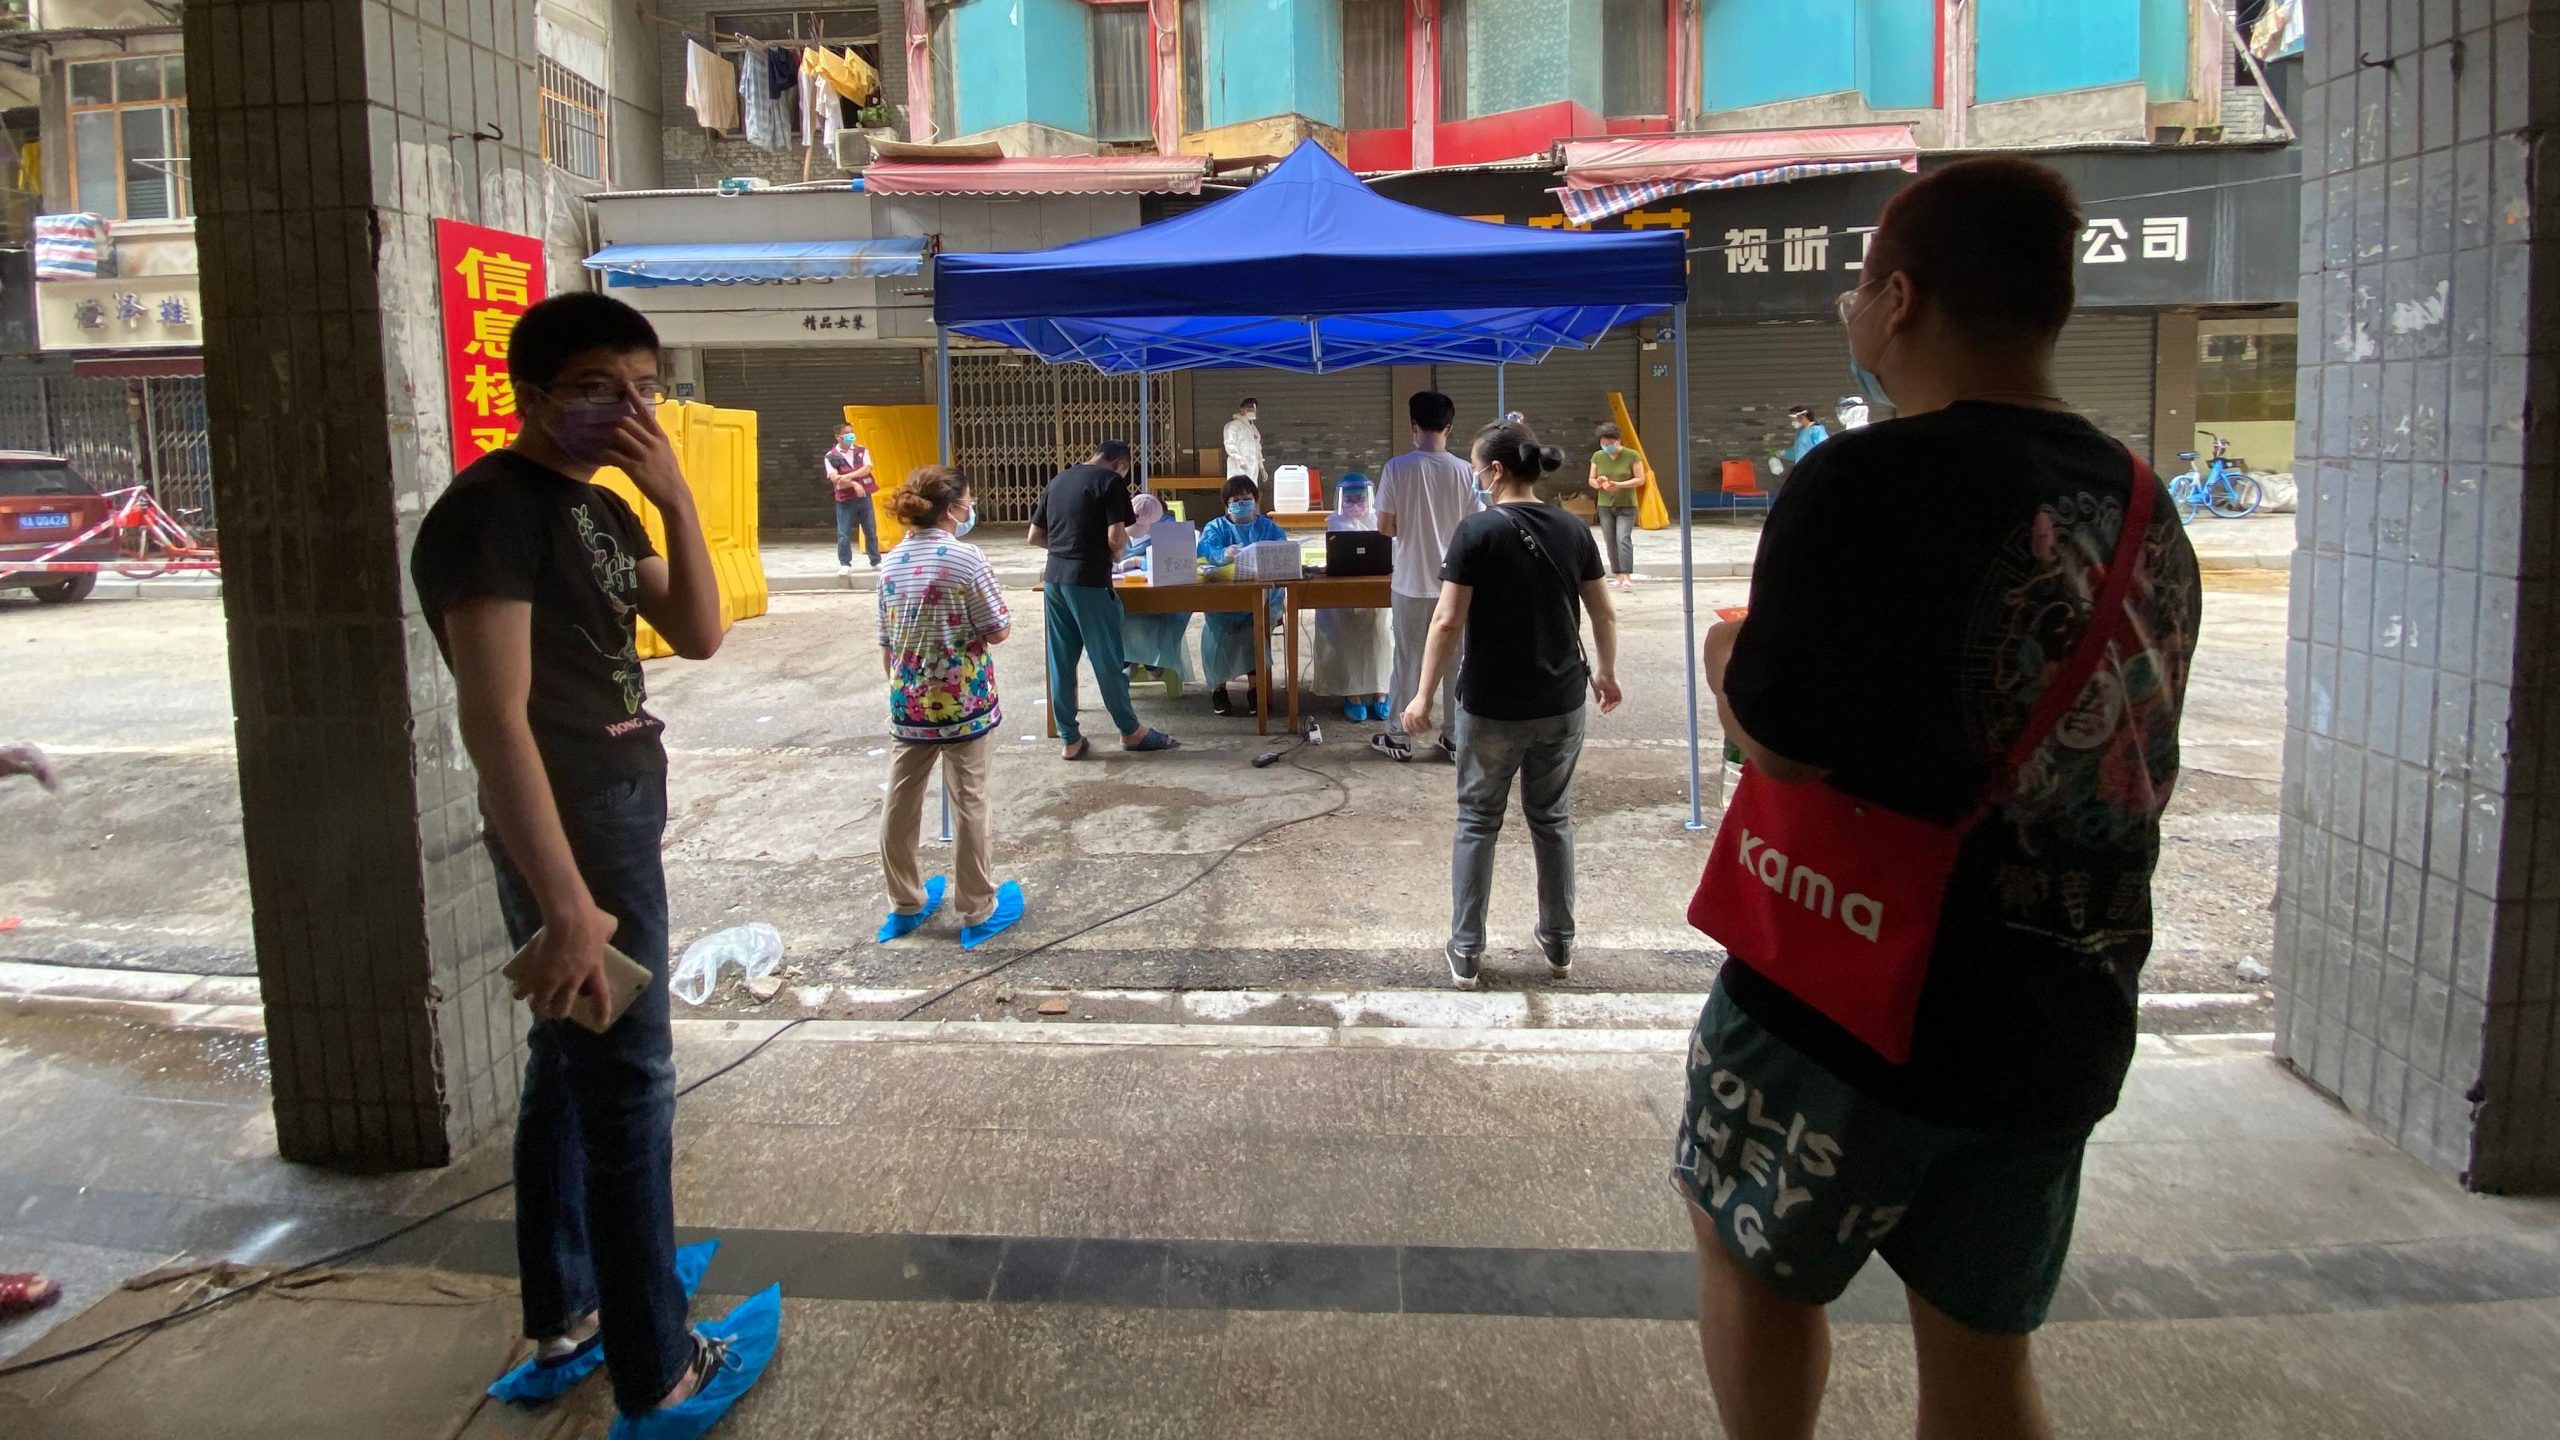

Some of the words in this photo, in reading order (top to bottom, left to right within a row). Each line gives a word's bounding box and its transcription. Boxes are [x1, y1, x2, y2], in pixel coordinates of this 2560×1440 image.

[455, 247, 532, 453] 信息核
[802, 313, 866, 331] 精品女装
[1738, 828, 1884, 943] kama
